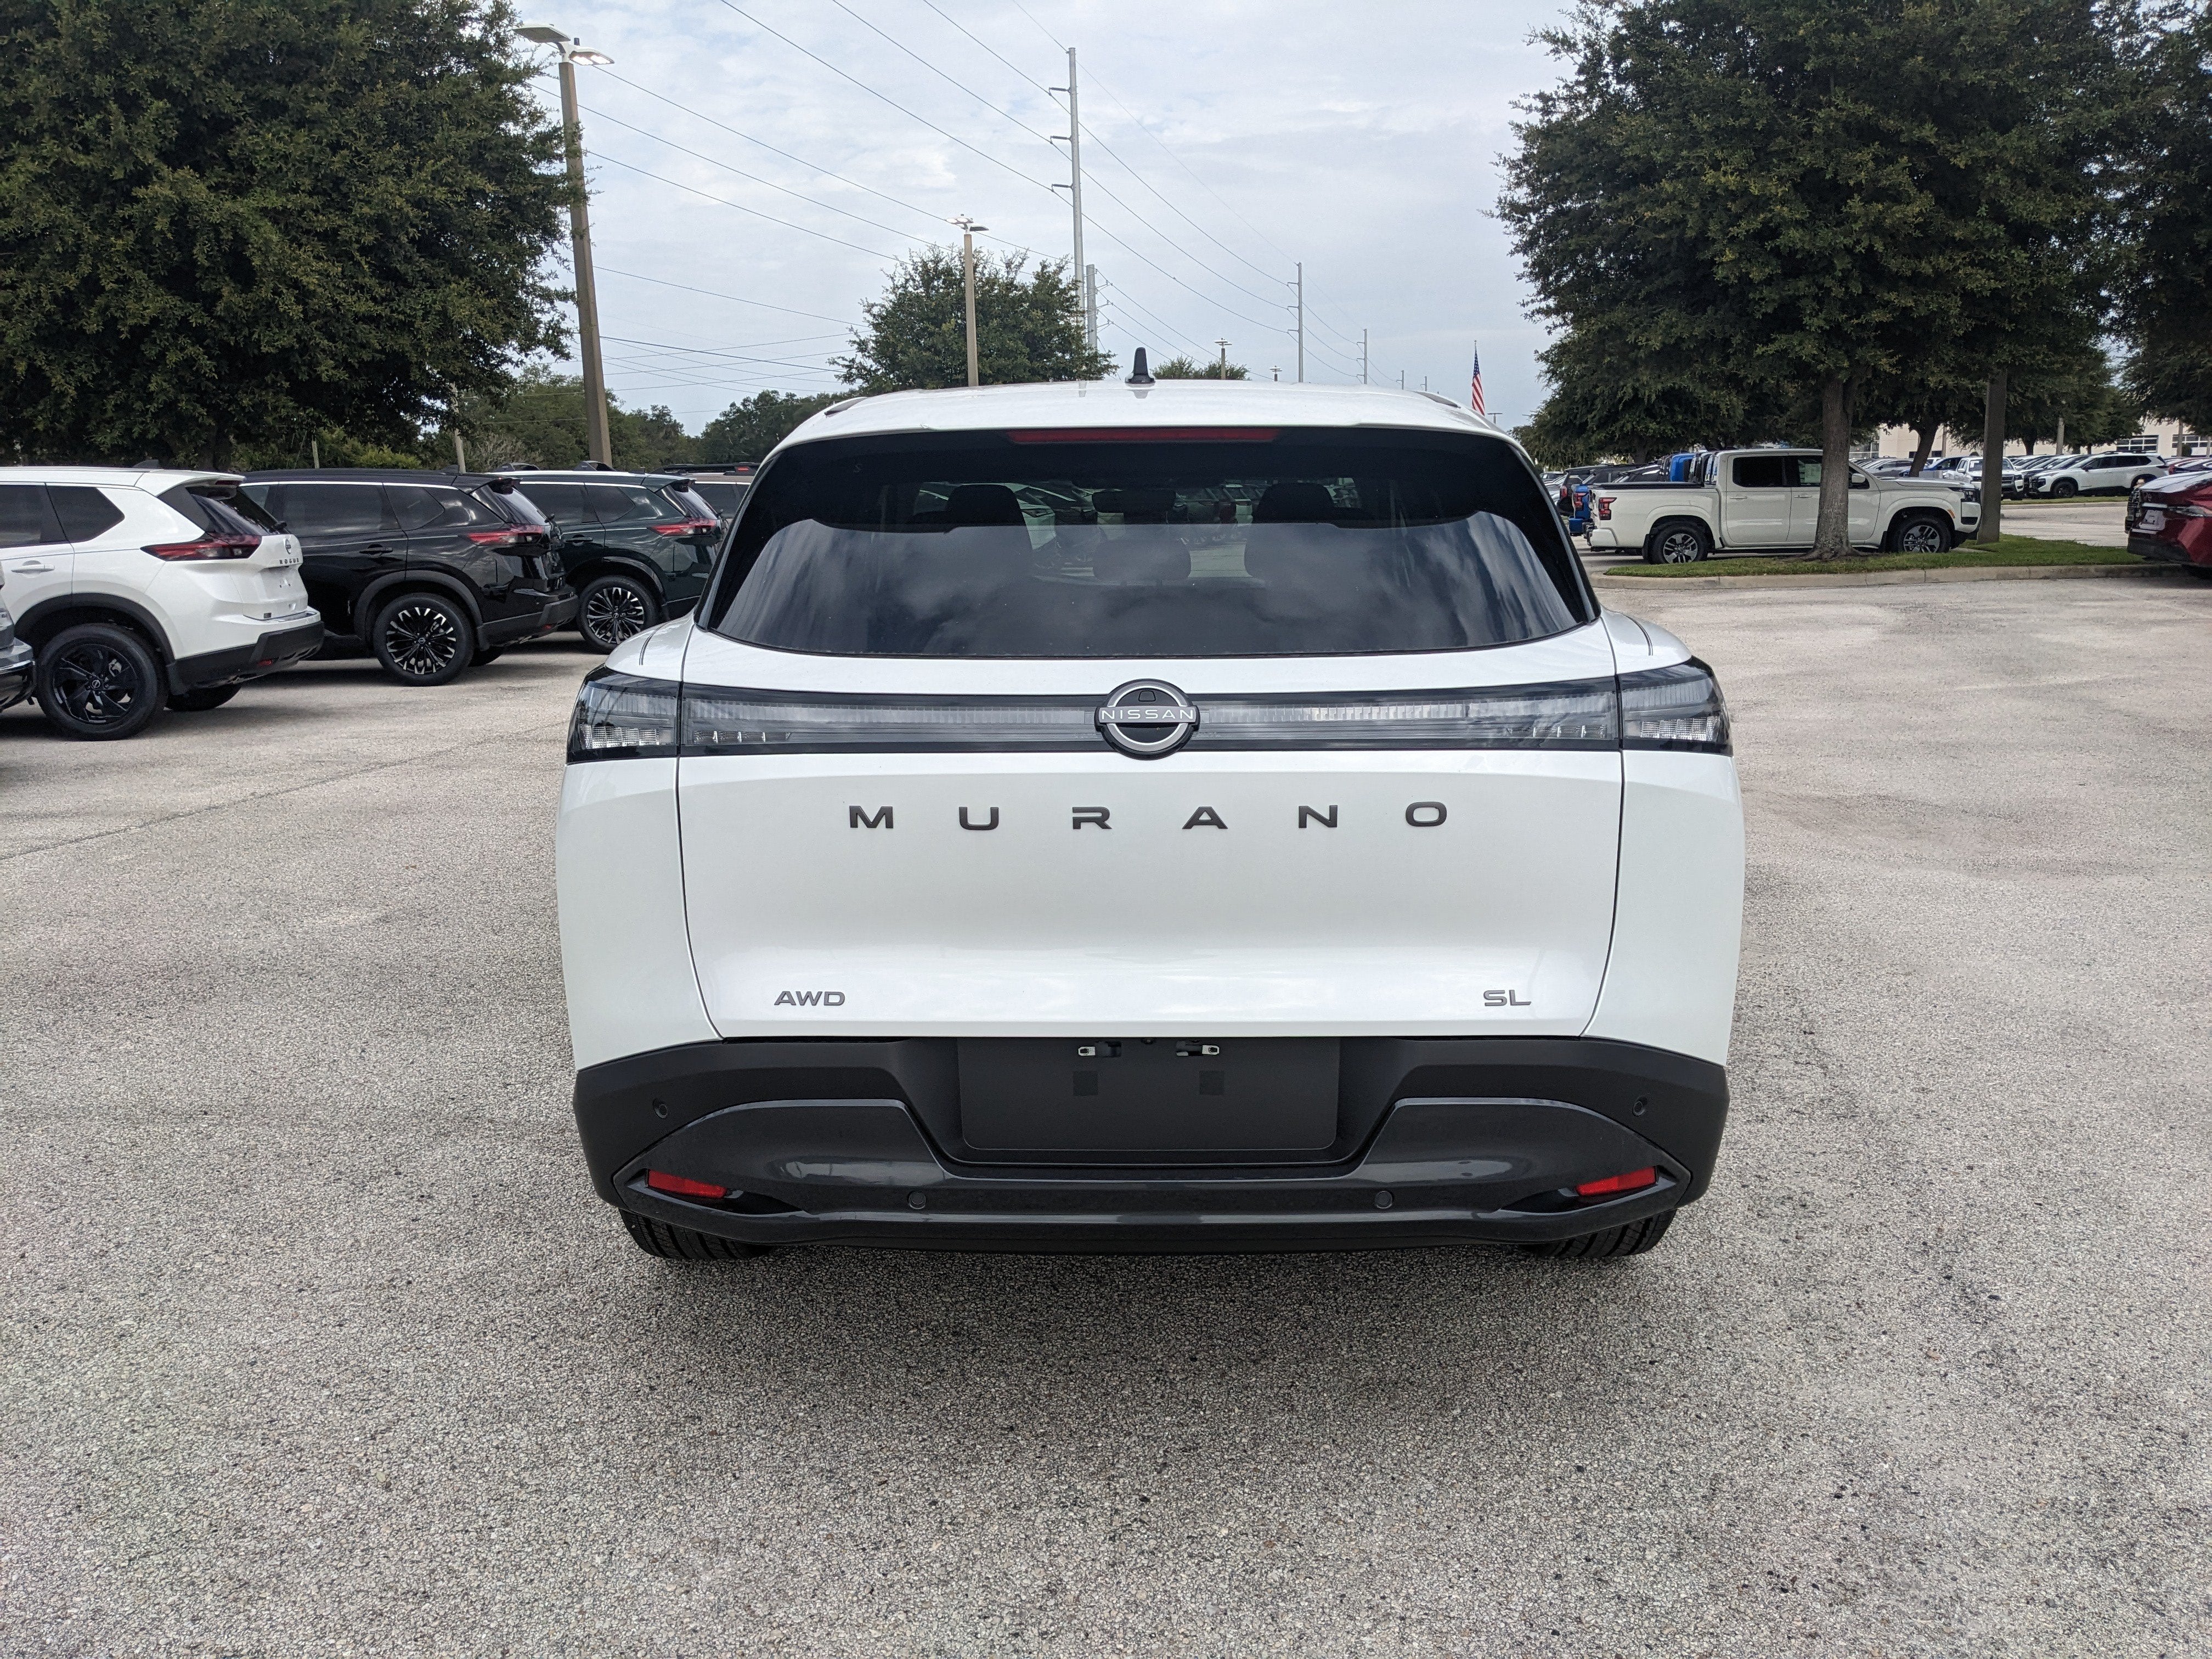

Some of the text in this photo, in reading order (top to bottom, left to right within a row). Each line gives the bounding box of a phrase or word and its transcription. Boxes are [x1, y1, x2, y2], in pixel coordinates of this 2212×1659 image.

[1101, 709, 1194, 720] NISSAN
[849, 801, 1447, 831] MURANO
[774, 991, 845, 1006] AWD
[1483, 989, 1531, 1006] SL
